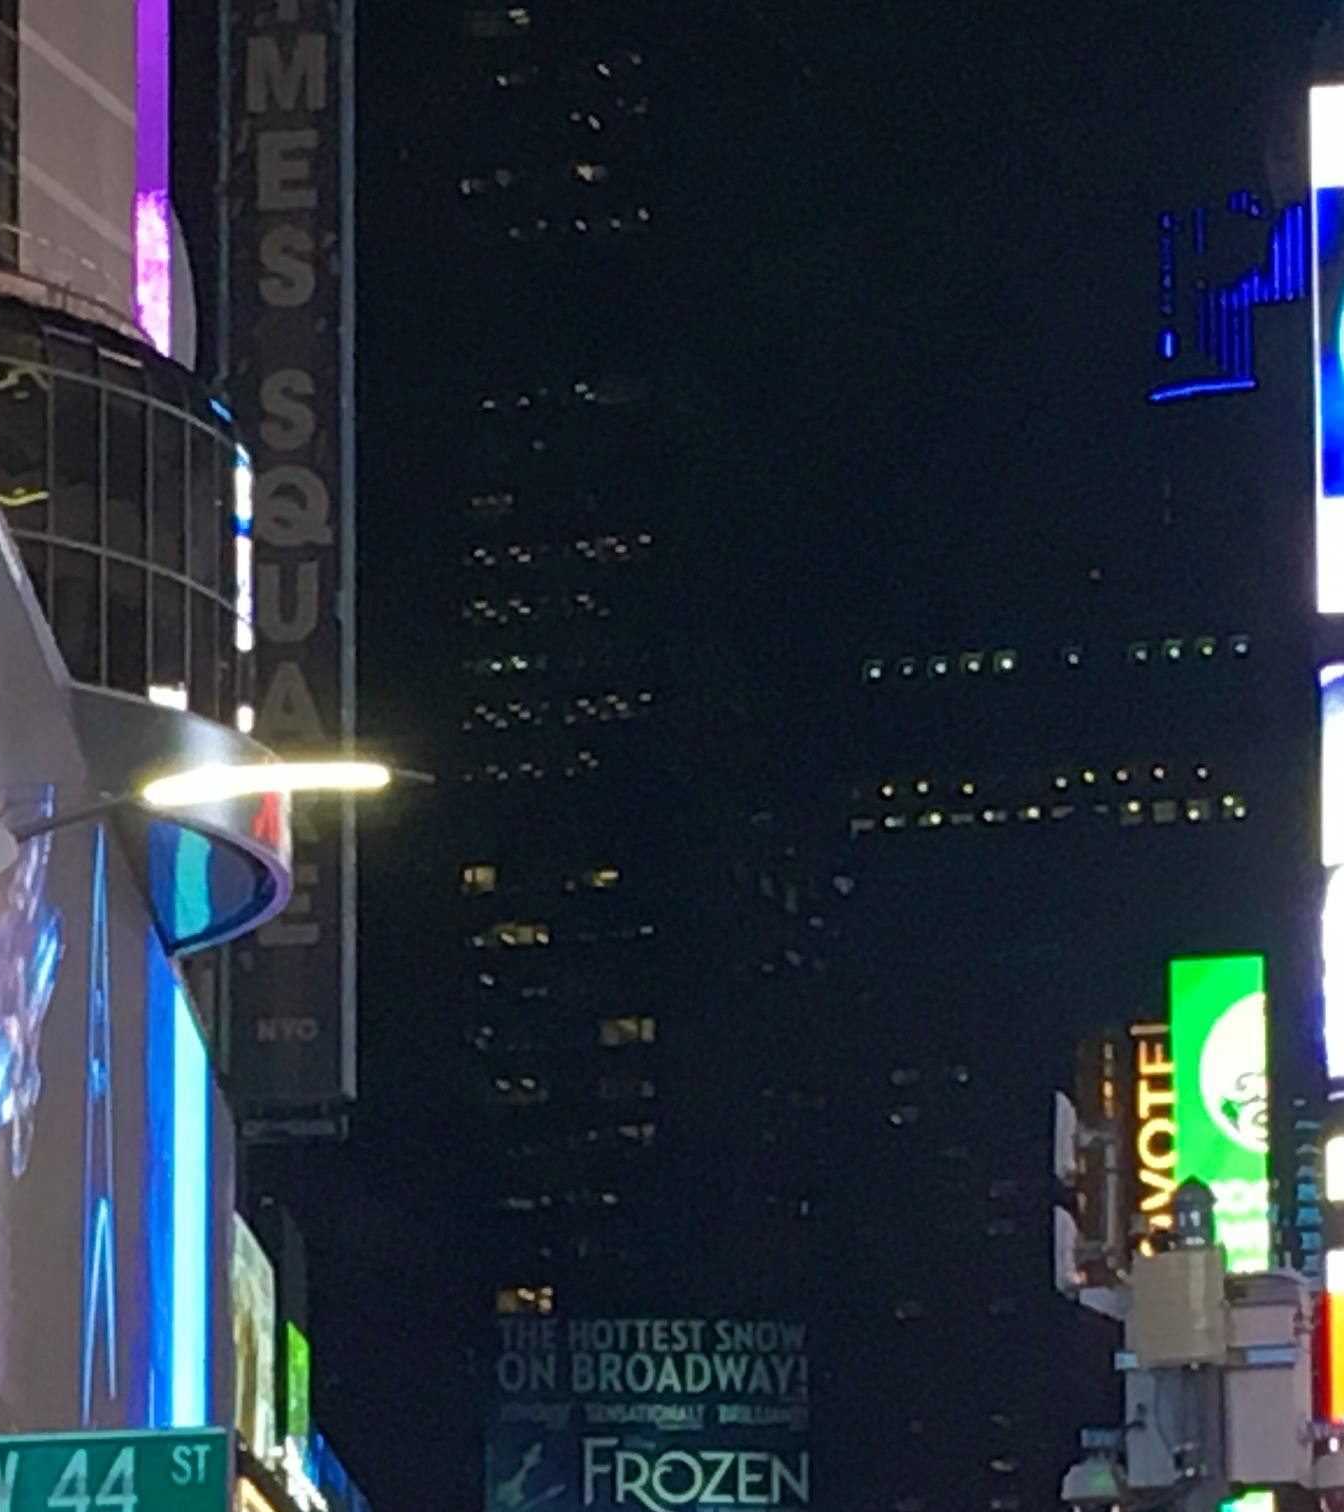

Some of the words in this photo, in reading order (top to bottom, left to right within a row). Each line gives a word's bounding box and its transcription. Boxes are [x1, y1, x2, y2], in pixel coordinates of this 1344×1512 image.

[243, 0, 328, 309] MES
[254, 368, 334, 946] SQUAE
[256, 1016, 319, 1044] NYC
[498, 1318, 559, 1352] THE
[568, 1318, 707, 1352] HOTTEST
[714, 1319, 807, 1352] SNOW
[496, 1353, 556, 1392] ON
[571, 1352, 809, 1394] BROADWAY!
[170, 1443, 211, 1487] ST
